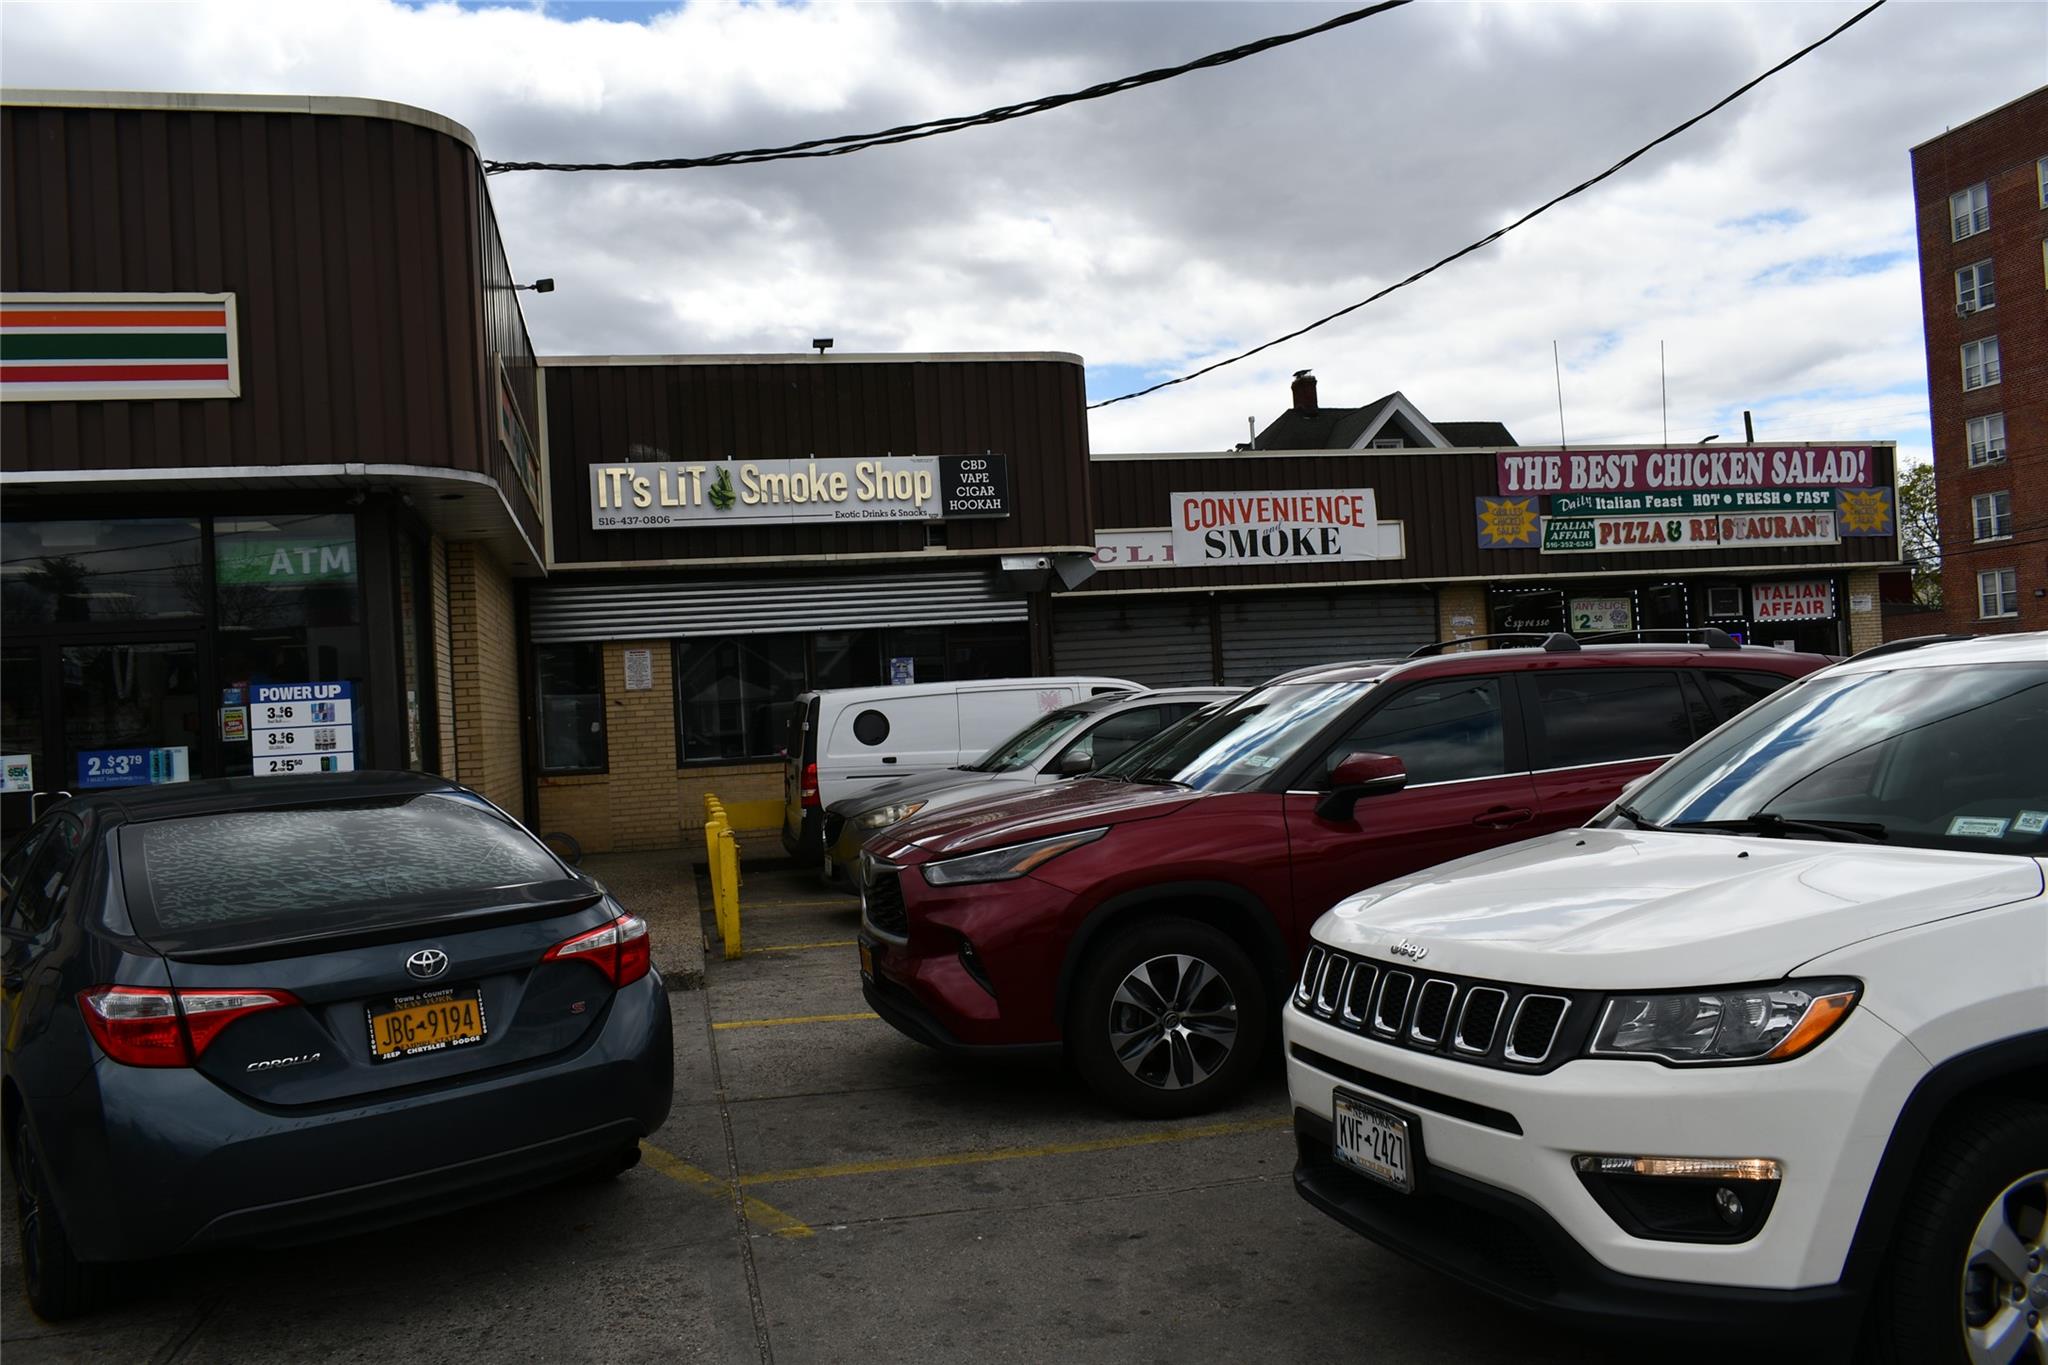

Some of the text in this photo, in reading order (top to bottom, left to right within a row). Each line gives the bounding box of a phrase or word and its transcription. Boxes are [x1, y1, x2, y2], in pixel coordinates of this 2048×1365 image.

[960, 459, 987, 470] CBD
[1504, 449, 1866, 490] THE BEST CHICKEN SALAD!
[740, 463, 848, 505] Smoke
[856, 461, 932, 507] Shop
[960, 473, 989, 484] VAPE
[956, 486, 995, 497] CIGAR
[949, 499, 1001, 510] HOOKAH
[1558, 491, 1829, 512] Daily Italian Feast HOT FRESH FAST
[598, 516, 670, 526] 516-437-0806
[835, 511, 861, 519] Exotic
[862, 510, 889, 518] Drinks
[898, 508, 927, 517] Snacks
[1183, 496, 1365, 531] CONVENIENCE
[1263, 518, 1283, 534] and
[1550, 521, 1594, 530] ITALIAN
[1598, 515, 1830, 544] PIZZA & RESTAURANT
[1205, 527, 1342, 559] SMOKE
[1550, 530, 1591, 540] AFFAIR
[269, 546, 351, 575] ATM
[1755, 584, 1826, 600] ITALIAN
[1575, 601, 1627, 610] ANY SLICE
[1759, 600, 1825, 616] AFFAIR
[1504, 616, 1550, 631] Espresso
[259, 685, 312, 702] POWER
[313, 684, 342, 699] UP
[267, 707, 275, 719] 3
[280, 706, 293, 718] $6
[268, 733, 276, 745] 3
[281, 732, 294, 744] $6
[87, 757, 101, 776] 2
[269, 760, 278, 772] 2
[1391, 938, 1429, 962] Jeep
[382, 1035, 481, 1060] JEEP CHRYSLER DODGE
[246, 1052, 321, 1072] COROLLA
[1352, 1107, 1370, 1121] NEW
